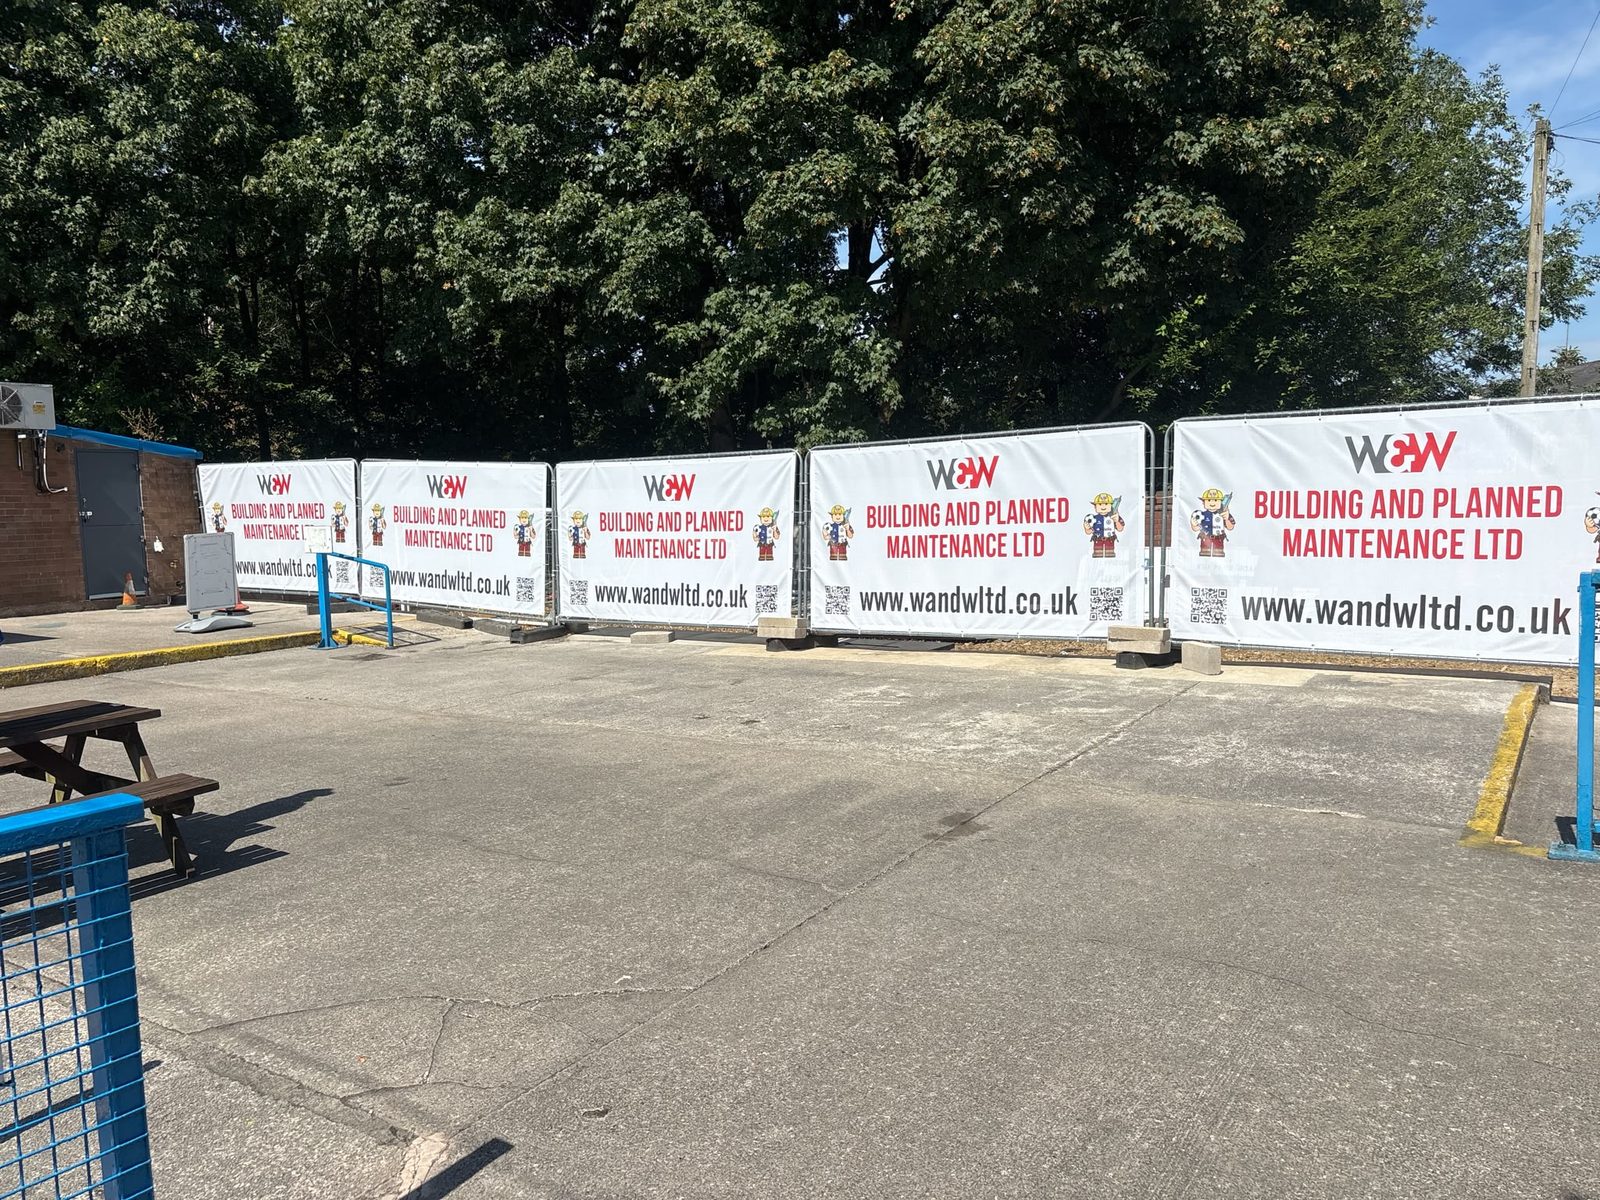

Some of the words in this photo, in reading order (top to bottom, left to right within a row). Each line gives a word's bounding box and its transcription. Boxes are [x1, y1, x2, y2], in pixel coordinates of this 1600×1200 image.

[231, 503, 267, 519] BUILDING
[270, 503, 285, 519] AND
[287, 503, 325, 519] PLANNED
[867, 503, 940, 528] BUILDING
[945, 501, 980, 526] AND
[986, 497, 1069, 525] PLANNED
[1255, 489, 1363, 519] BUILDING
[1370, 489, 1424, 519] AND
[1433, 486, 1562, 518] PLANNED
[394, 506, 435, 525] BUILDING
[438, 507, 457, 526] AND
[460, 509, 506, 529] PLANNED
[600, 512, 653, 532] BUILDING
[657, 512, 681, 532] AND
[686, 510, 743, 532] PLANNED
[244, 524, 300, 540] MAINTENANCE
[405, 529, 472, 551] MAINTENANCE
[475, 534, 493, 552] LTD
[887, 533, 1007, 558] MAINTENANCE
[1013, 532, 1044, 557] LTD
[1283, 529, 1465, 559] MAINTENANCE
[1474, 529, 1523, 560] LTD
[615, 538, 700, 559] MAINTENANCE
[705, 539, 726, 559] LTD
[390, 569, 510, 596] www.wandwltd.co.uk
[595, 582, 748, 608] www.wandwltd.co.uk
[860, 586, 1078, 615] www.wandwltd.co.uk
[1241, 593, 1571, 635] www.wandwltd.co.uk
